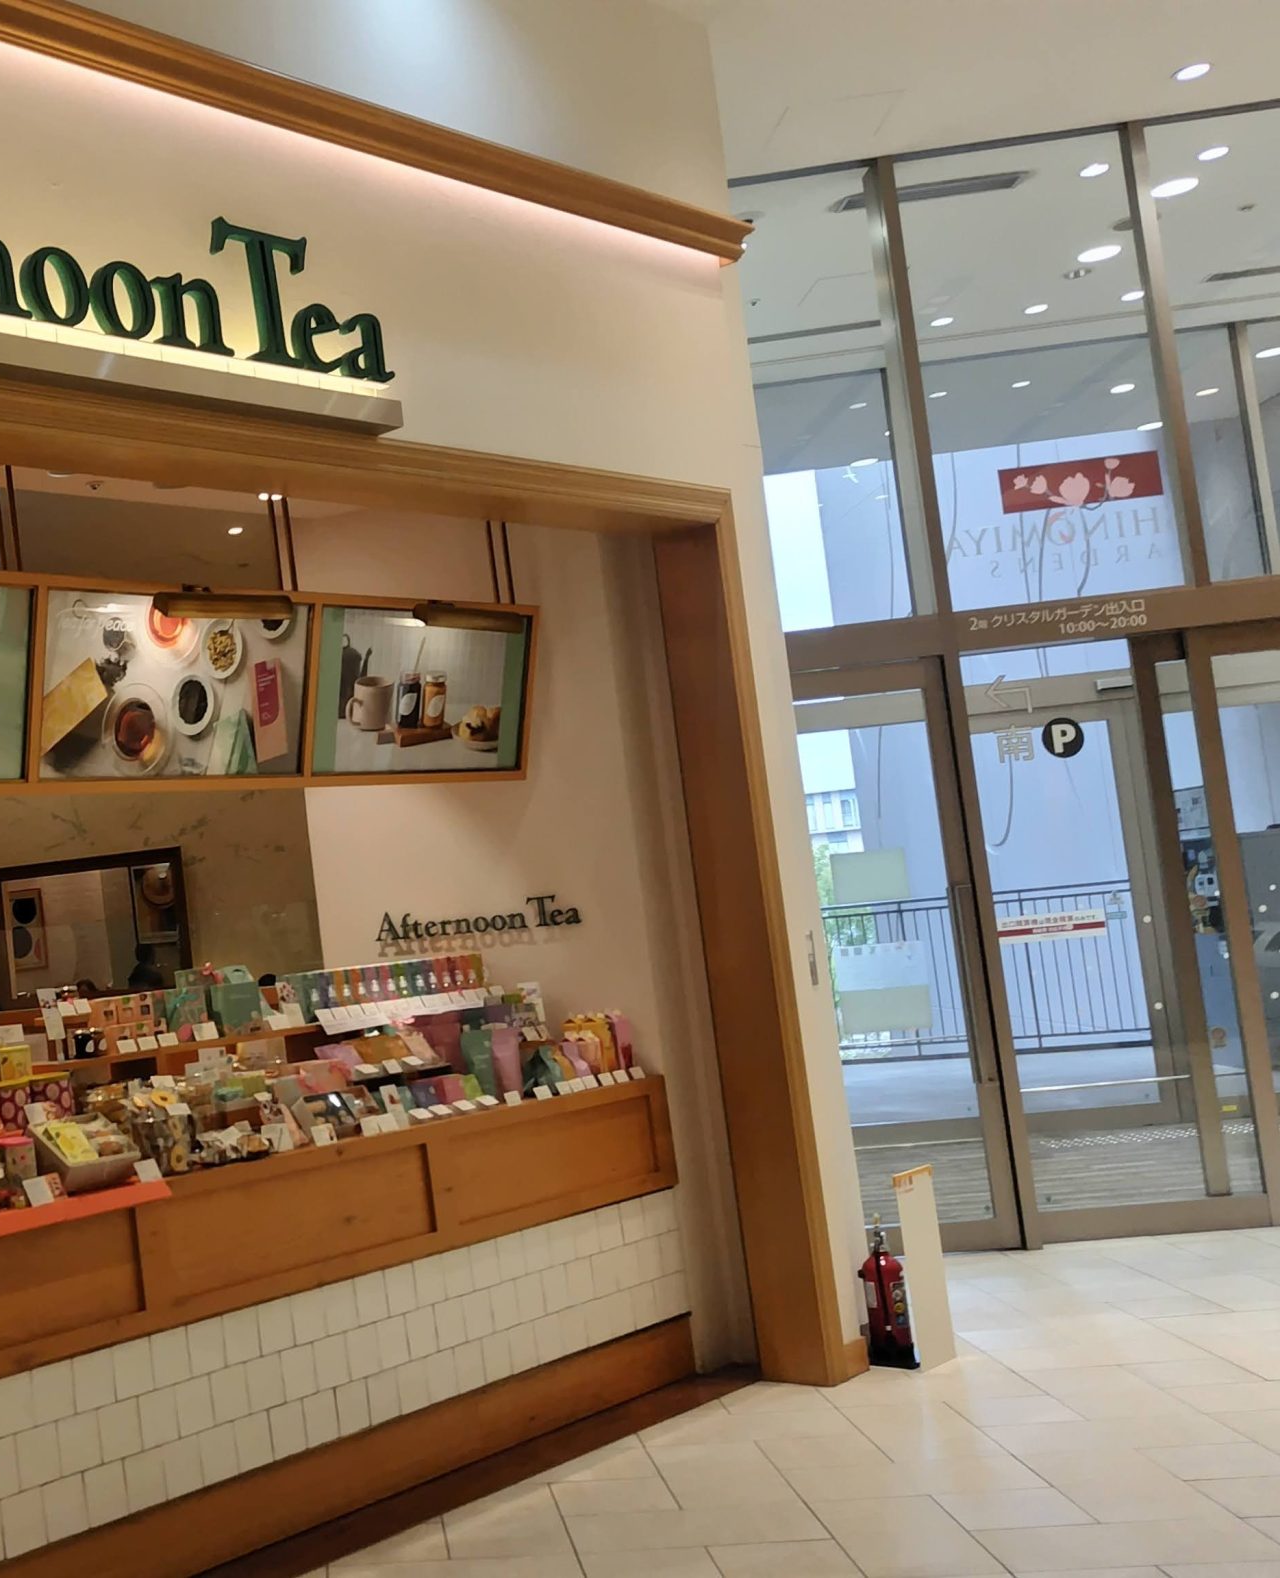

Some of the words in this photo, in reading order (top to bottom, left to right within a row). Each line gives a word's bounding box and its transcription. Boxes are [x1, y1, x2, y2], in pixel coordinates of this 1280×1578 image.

[210, 215, 397, 385] Tea
[993, 723, 1035, 764] 南
[375, 911, 527, 942] Afternoon
[526, 894, 583, 928] Tea
